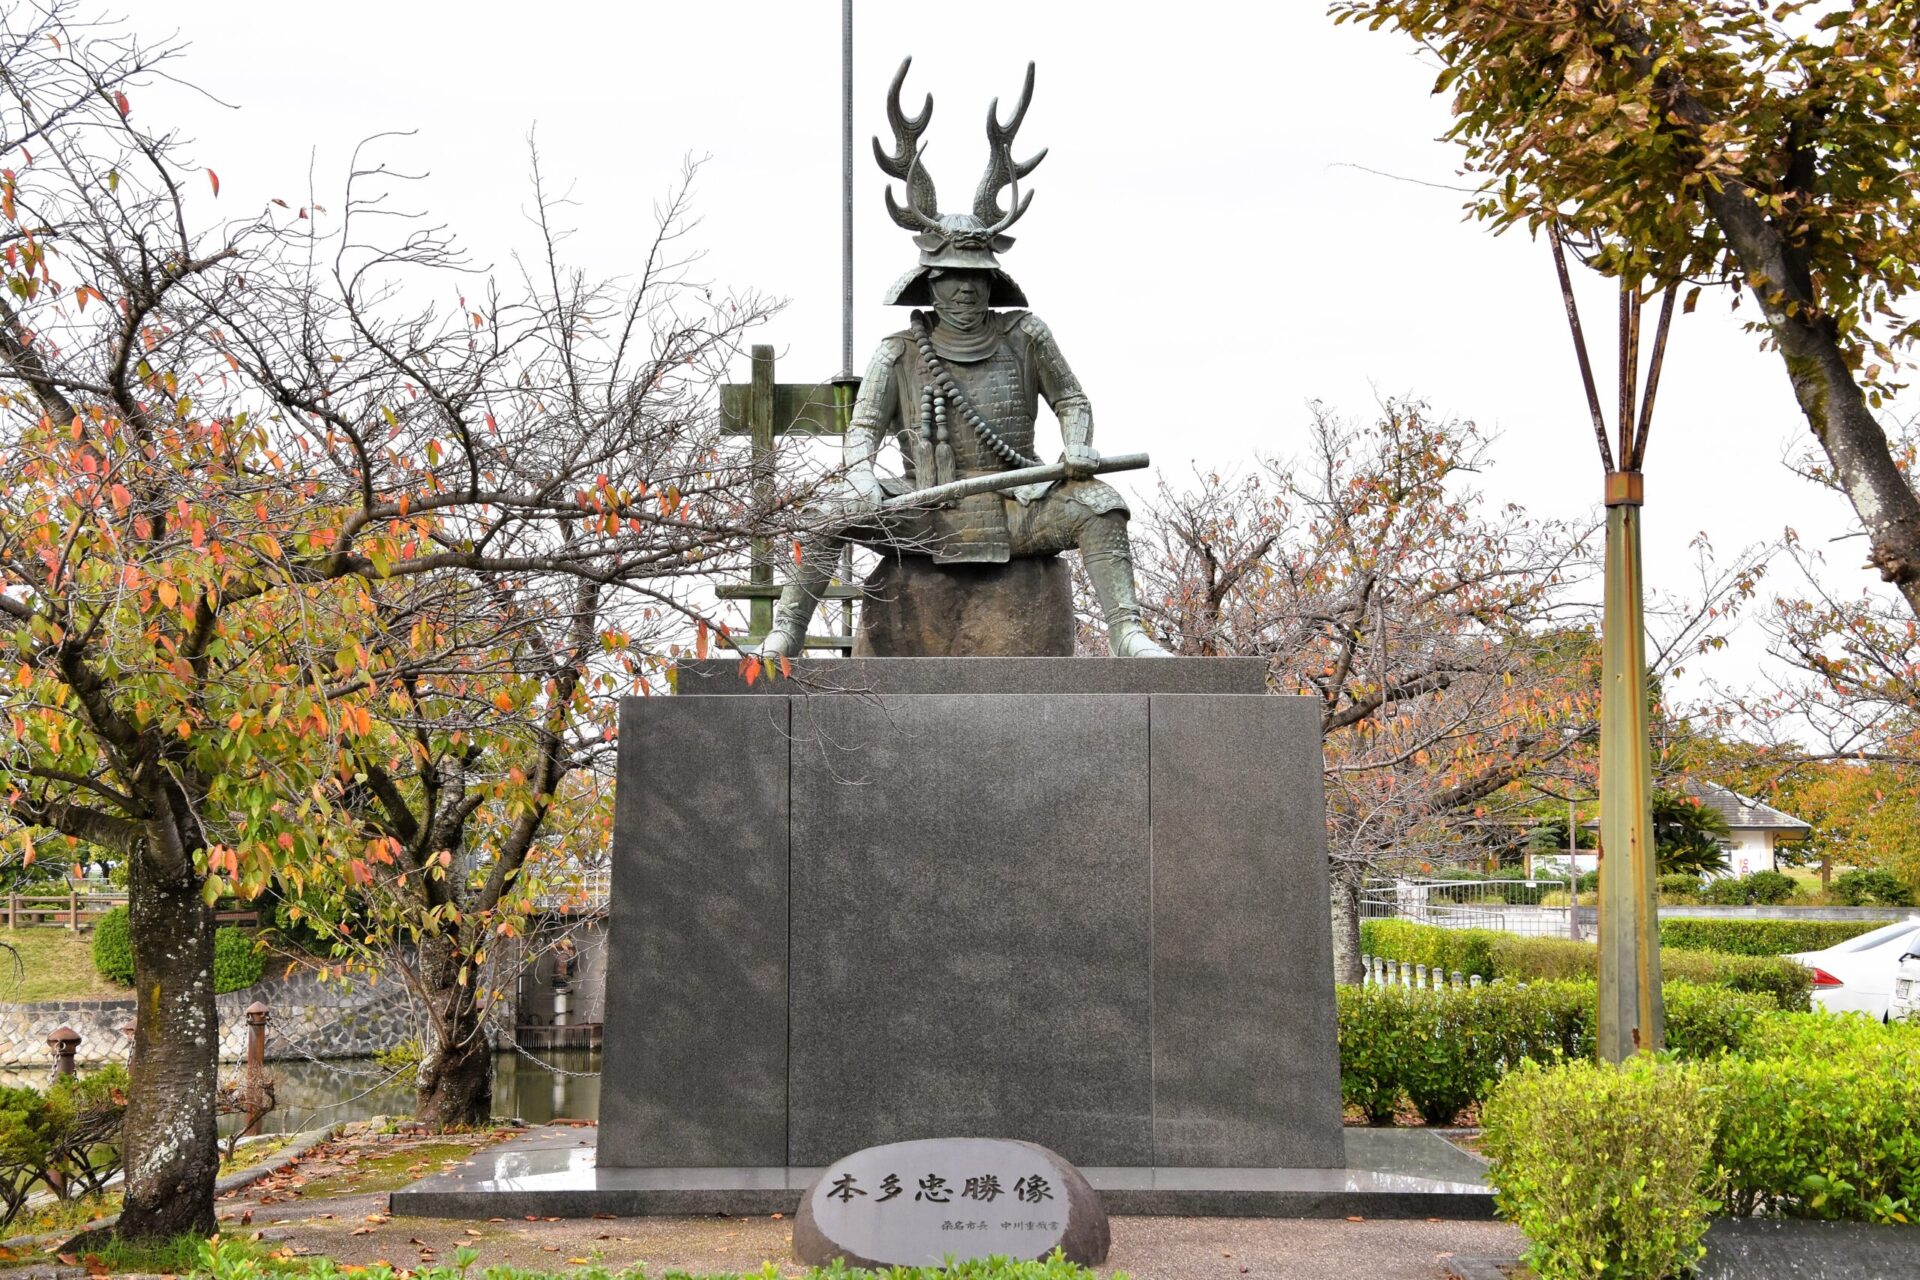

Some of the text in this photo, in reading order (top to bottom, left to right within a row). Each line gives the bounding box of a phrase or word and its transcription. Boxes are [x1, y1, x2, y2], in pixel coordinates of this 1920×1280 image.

[826, 1173, 1055, 1203] 本多忠勝像
[941, 1220, 989, 1232] 桑名市長
